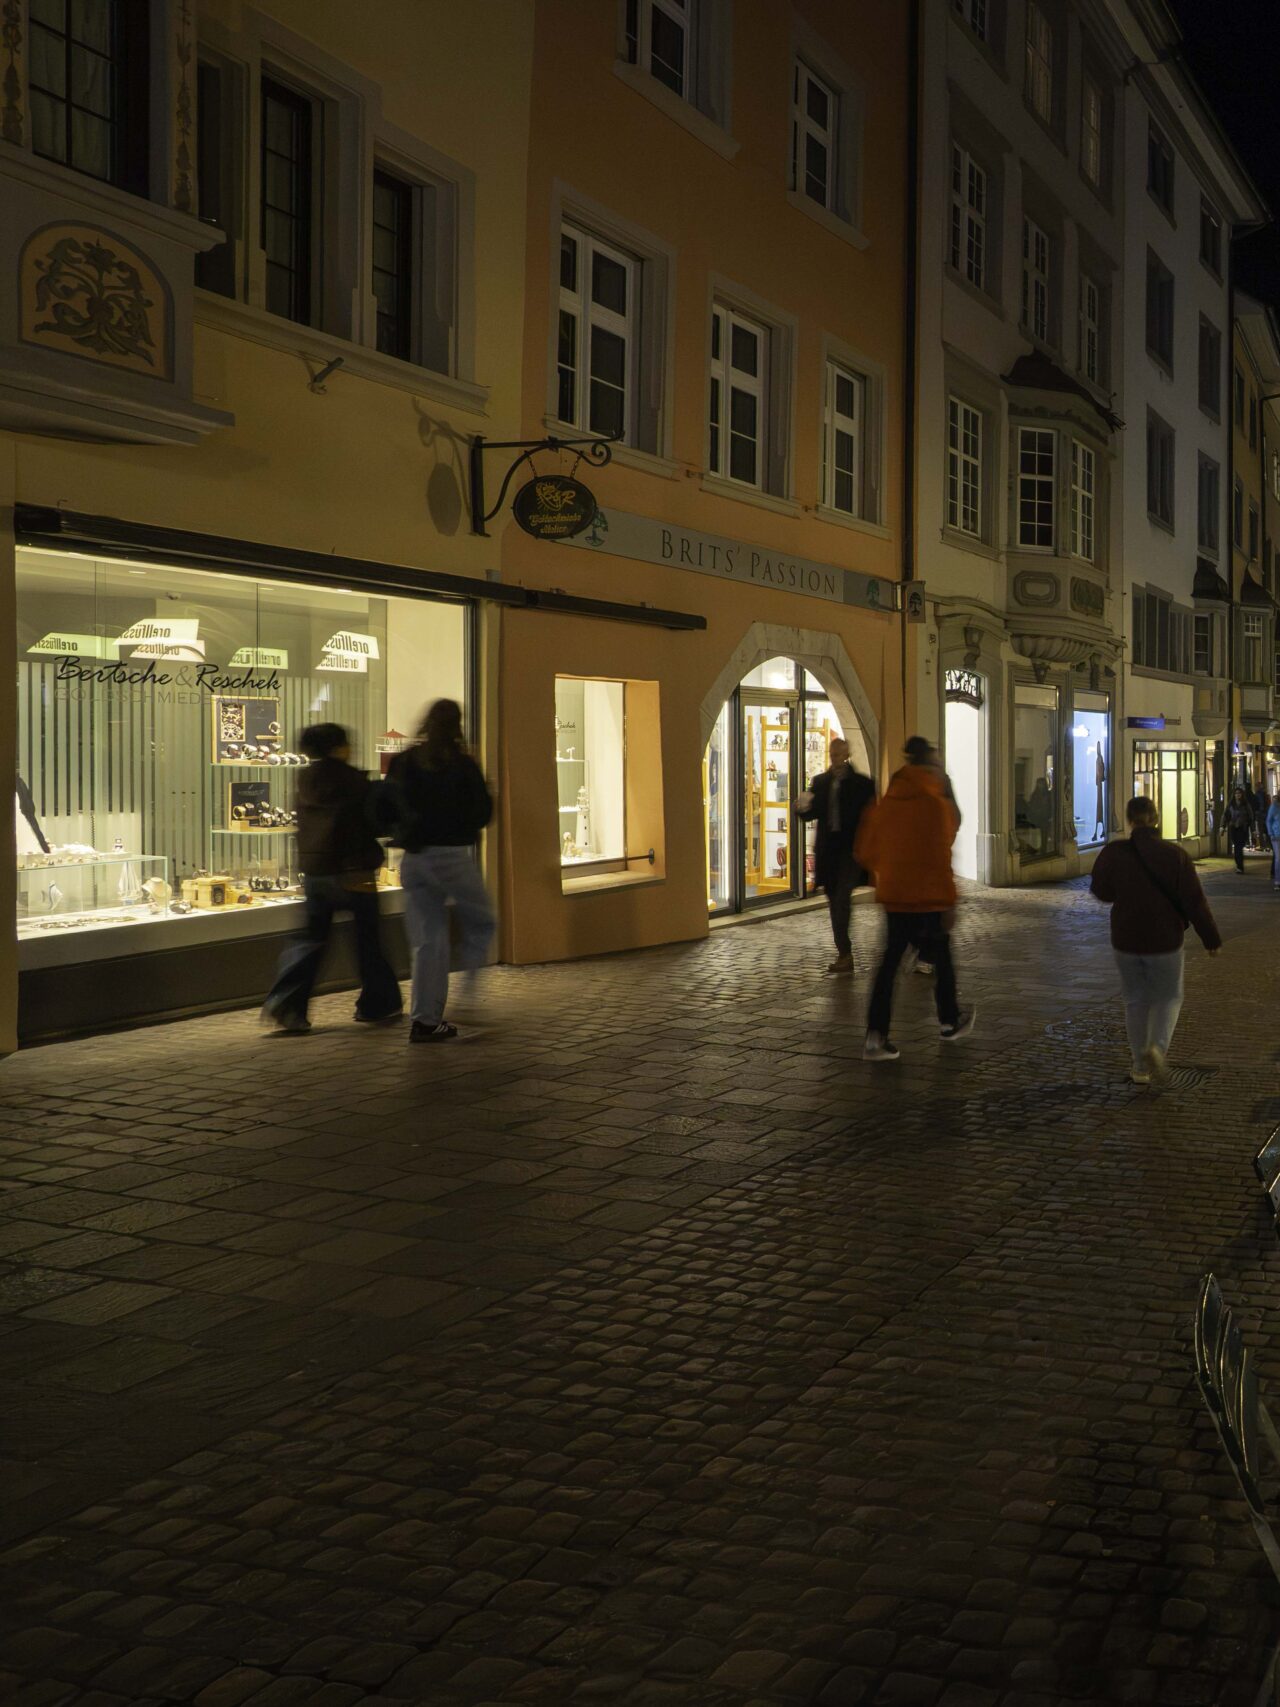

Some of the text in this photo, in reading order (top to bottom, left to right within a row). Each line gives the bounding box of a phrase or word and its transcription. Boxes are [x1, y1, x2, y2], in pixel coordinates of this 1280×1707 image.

[54, 655, 282, 693] Bertsche & Reschek
